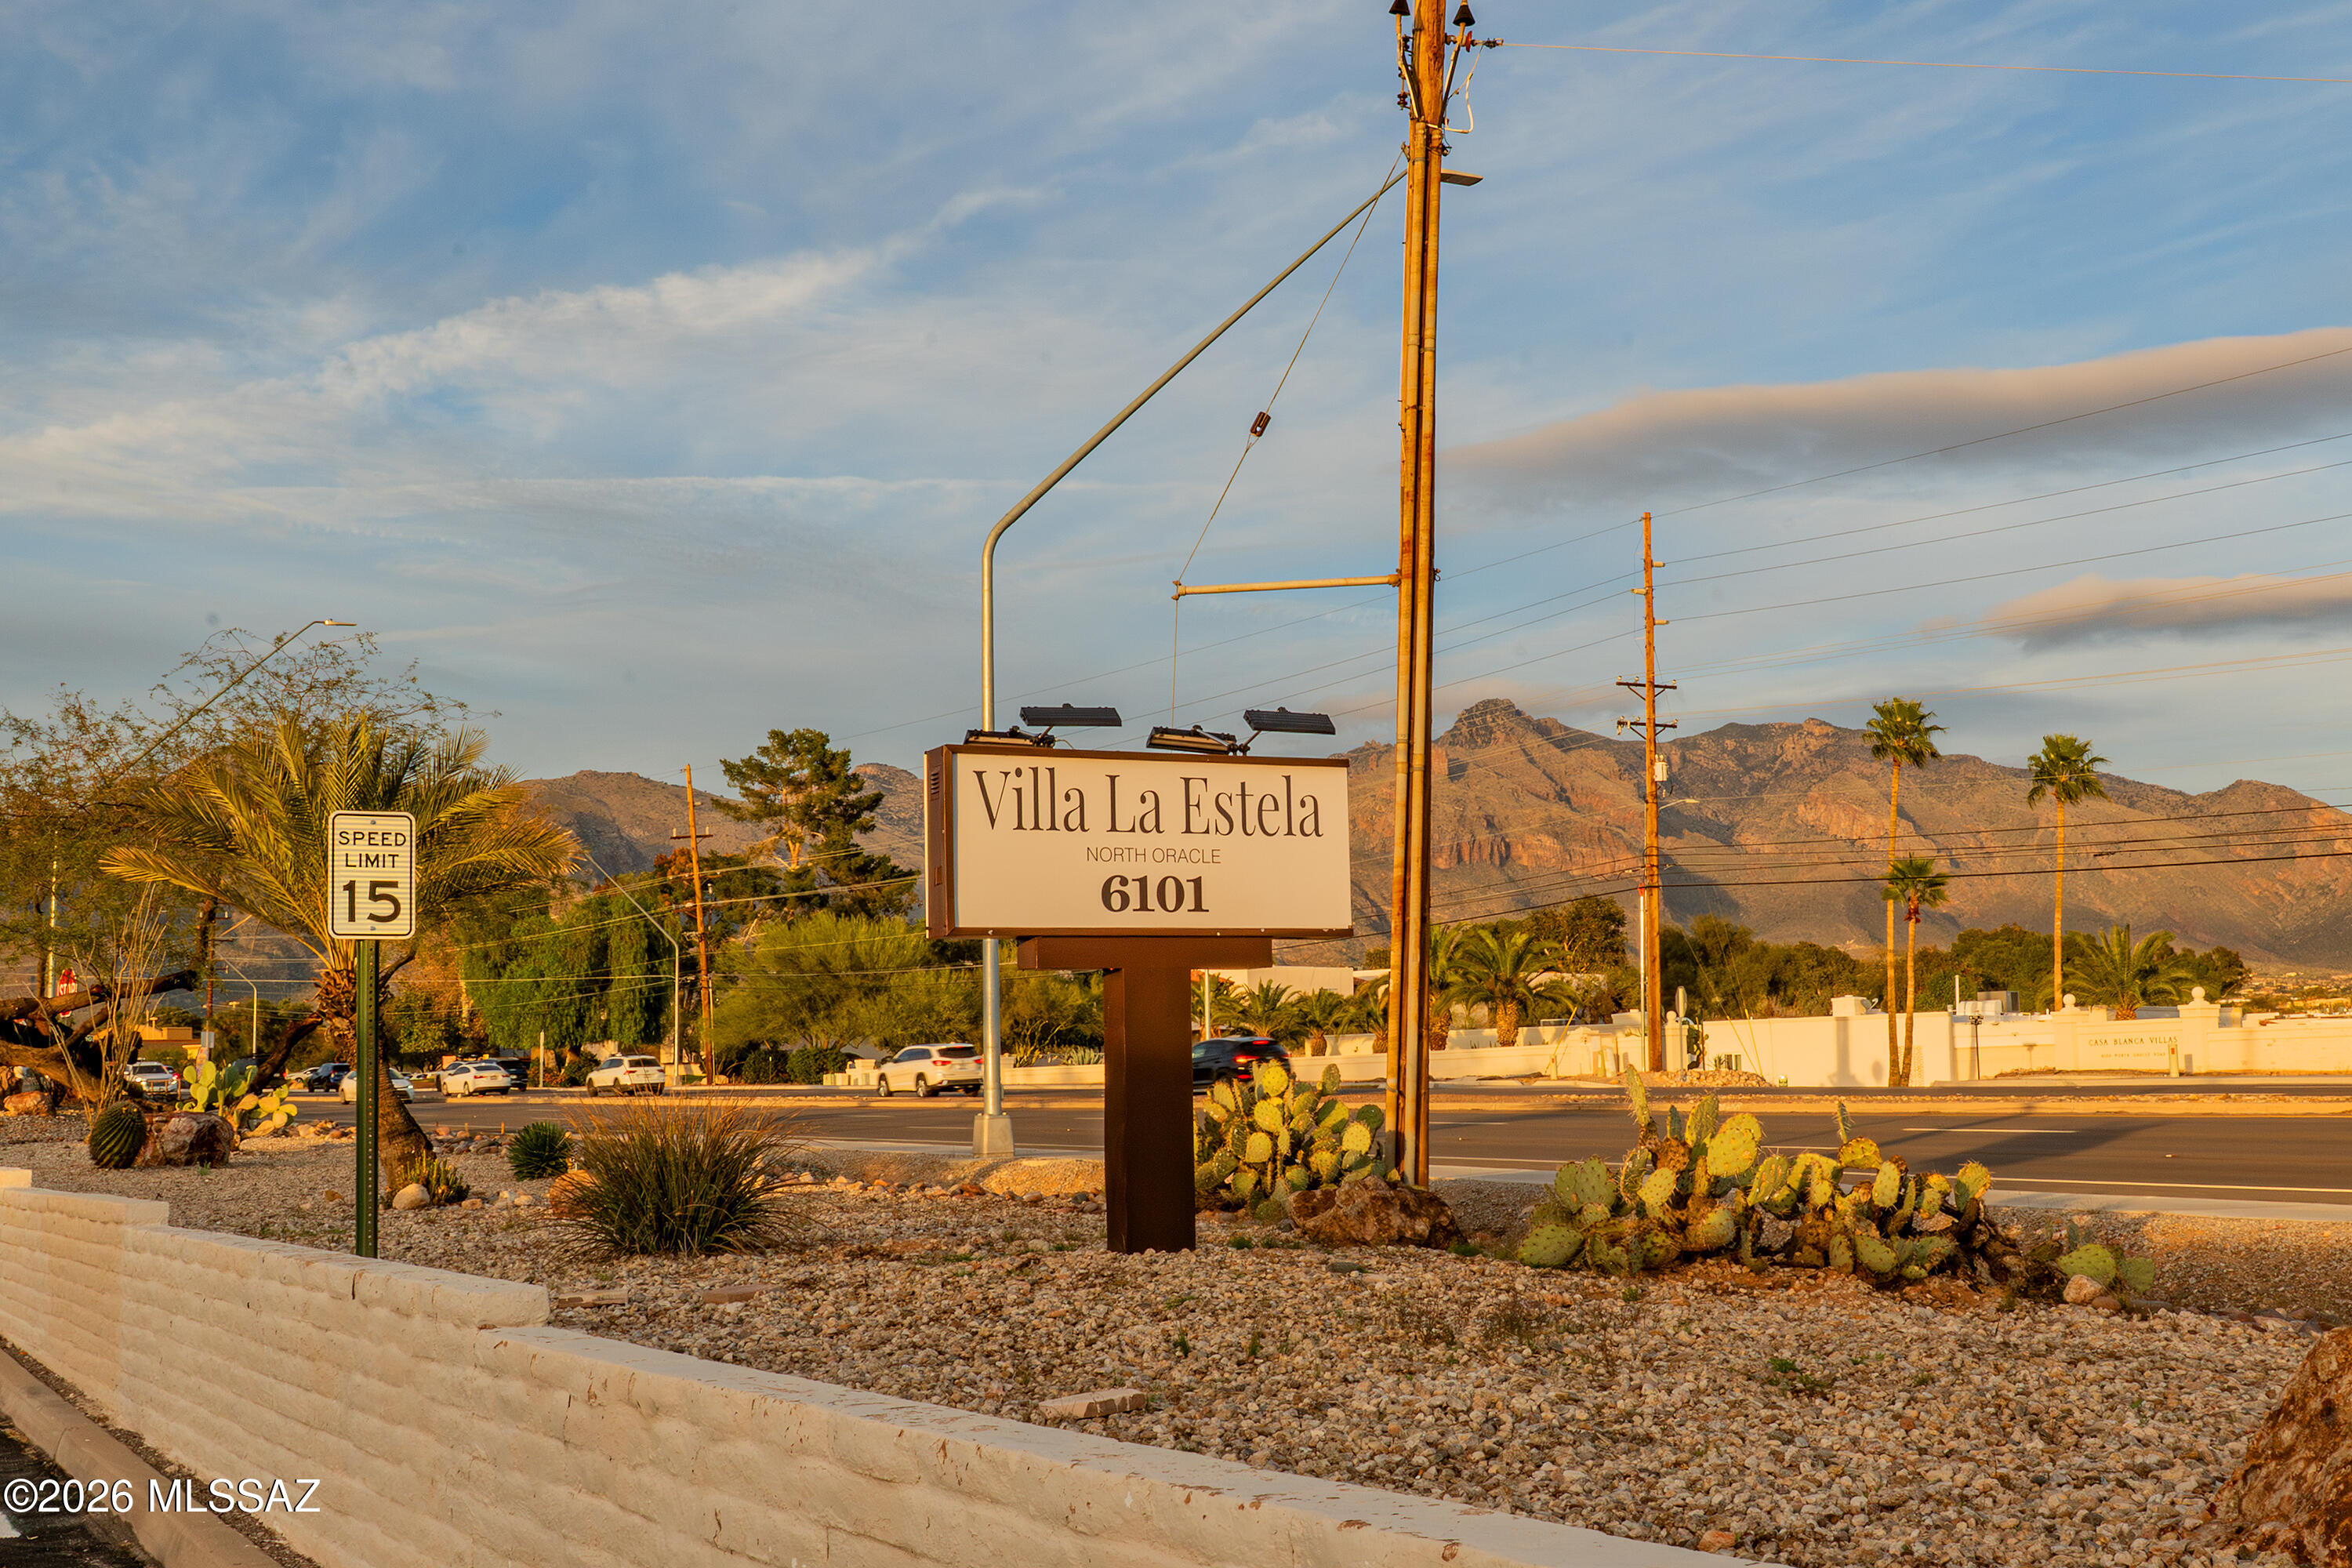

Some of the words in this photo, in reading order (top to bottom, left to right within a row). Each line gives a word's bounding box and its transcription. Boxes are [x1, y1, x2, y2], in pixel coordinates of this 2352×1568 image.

[973, 766, 1089, 833] Villa
[1105, 774, 1165, 834] La
[1179, 775, 1324, 837] Estela
[339, 831, 407, 846] SPEED
[345, 853, 399, 868] LIMIT
[1087, 847, 1146, 863] NORTH
[1152, 848, 1221, 864] ORACLE
[343, 880, 401, 923] 15
[1101, 874, 1210, 913] 6101
[2114, 1037, 2144, 1046] BLANCA
[2149, 1036, 2178, 1044] VILLAS
